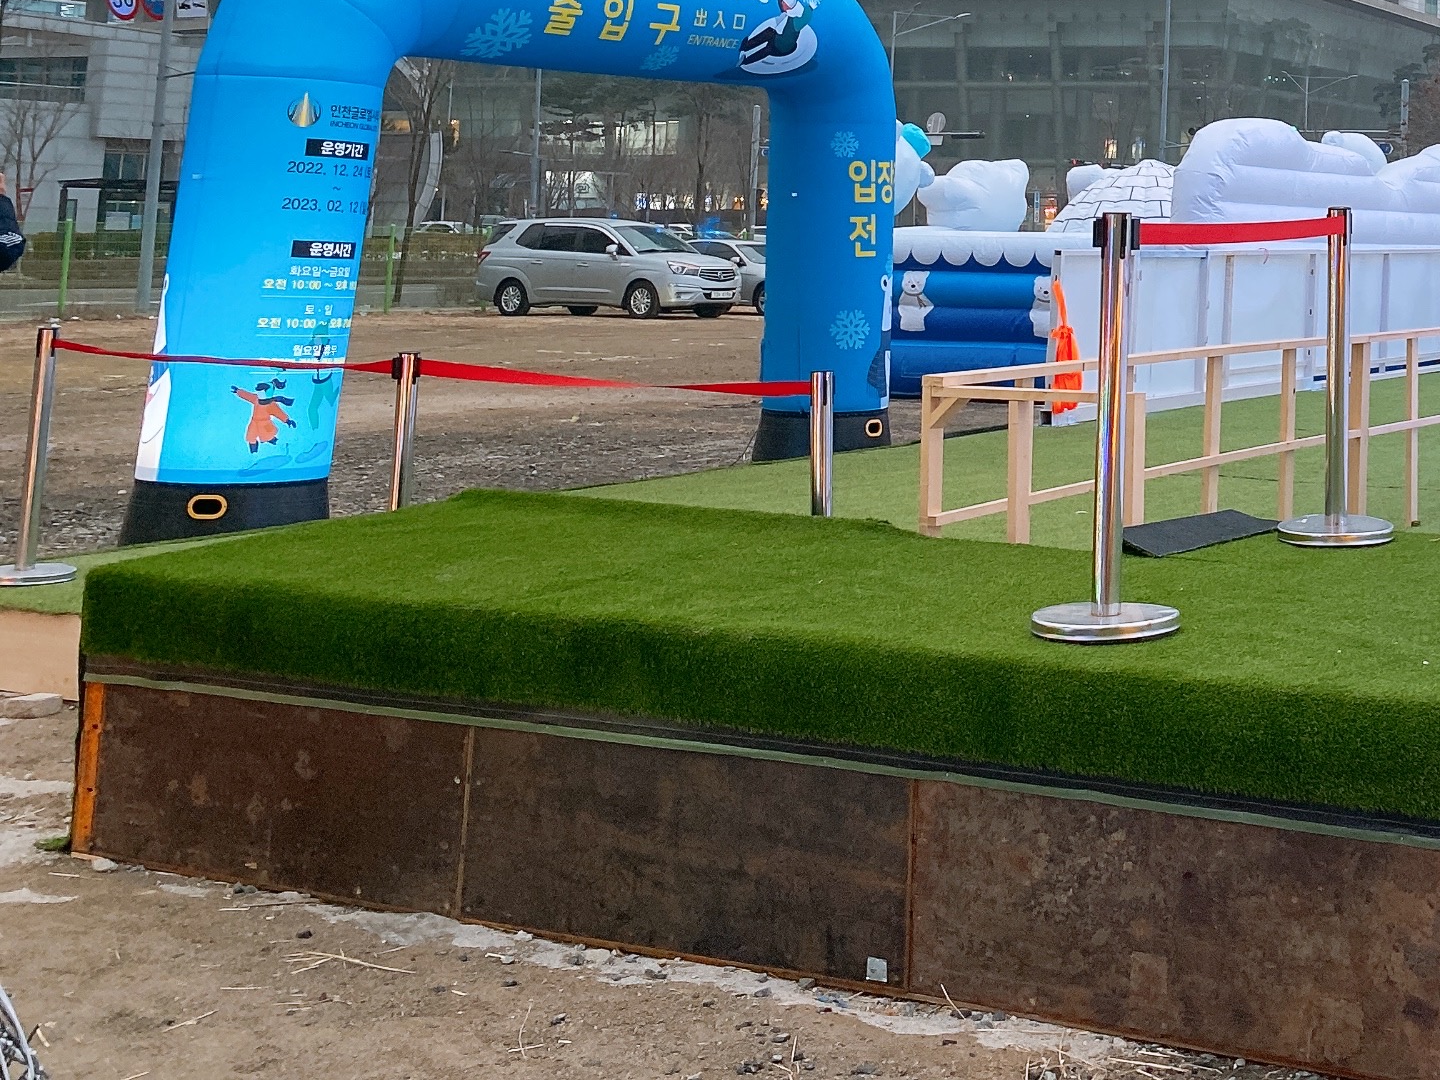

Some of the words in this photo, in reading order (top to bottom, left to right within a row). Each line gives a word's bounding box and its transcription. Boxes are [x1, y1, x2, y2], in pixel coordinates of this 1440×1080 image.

[693, 7, 746, 31] 出入口
[687, 34, 740, 50] ENTRANCE
[320, 141, 364, 157] 운영기간
[286, 161, 327, 175] 2022.
[333, 164, 349, 177] 12.
[848, 159, 894, 204] 입장
[281, 197, 322, 212] 2023.
[326, 200, 344, 213] 02.
[849, 214, 876, 257] 전
[309, 242, 352, 257] 운영시간
[262, 278, 287, 290] 오전
[291, 280, 321, 290] 10:00
[256, 317, 281, 328] 오전
[286, 318, 316, 328] 10:00
